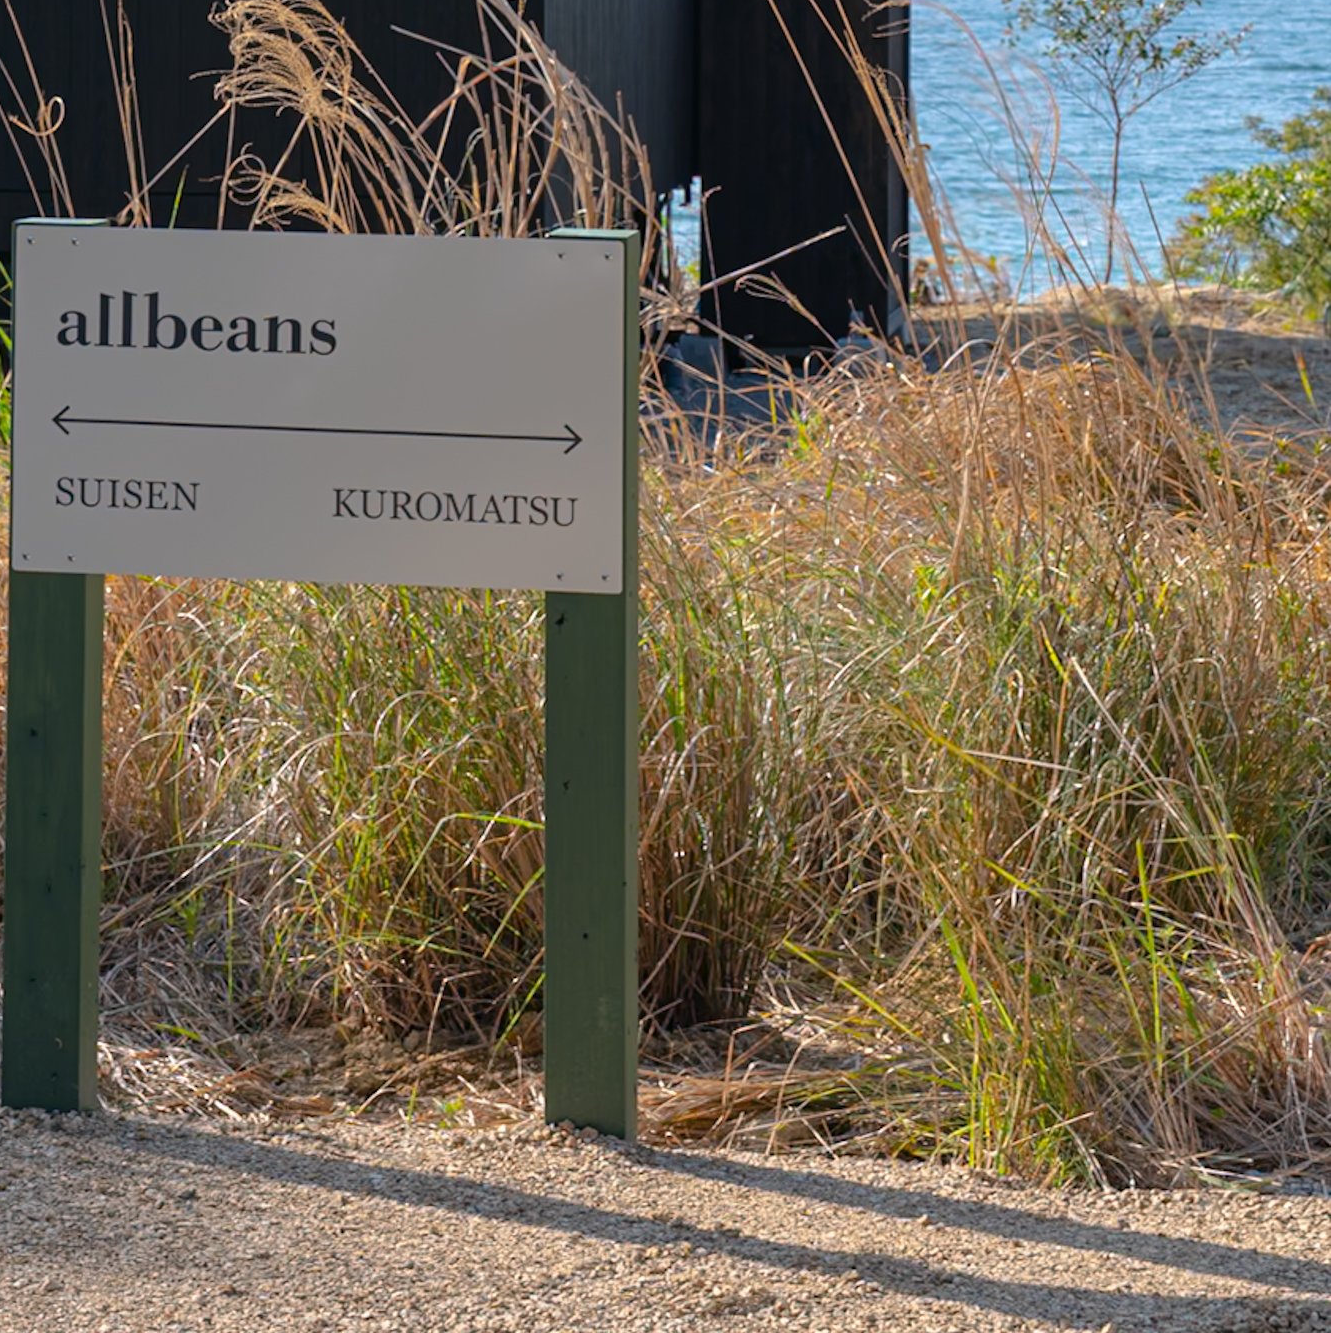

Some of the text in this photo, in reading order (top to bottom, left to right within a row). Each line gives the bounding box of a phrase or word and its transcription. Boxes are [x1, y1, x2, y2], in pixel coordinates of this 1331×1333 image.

[56, 290, 337, 356] allbeans
[55, 476, 201, 511] SUISEN
[332, 487, 578, 527] KUROMATSU
